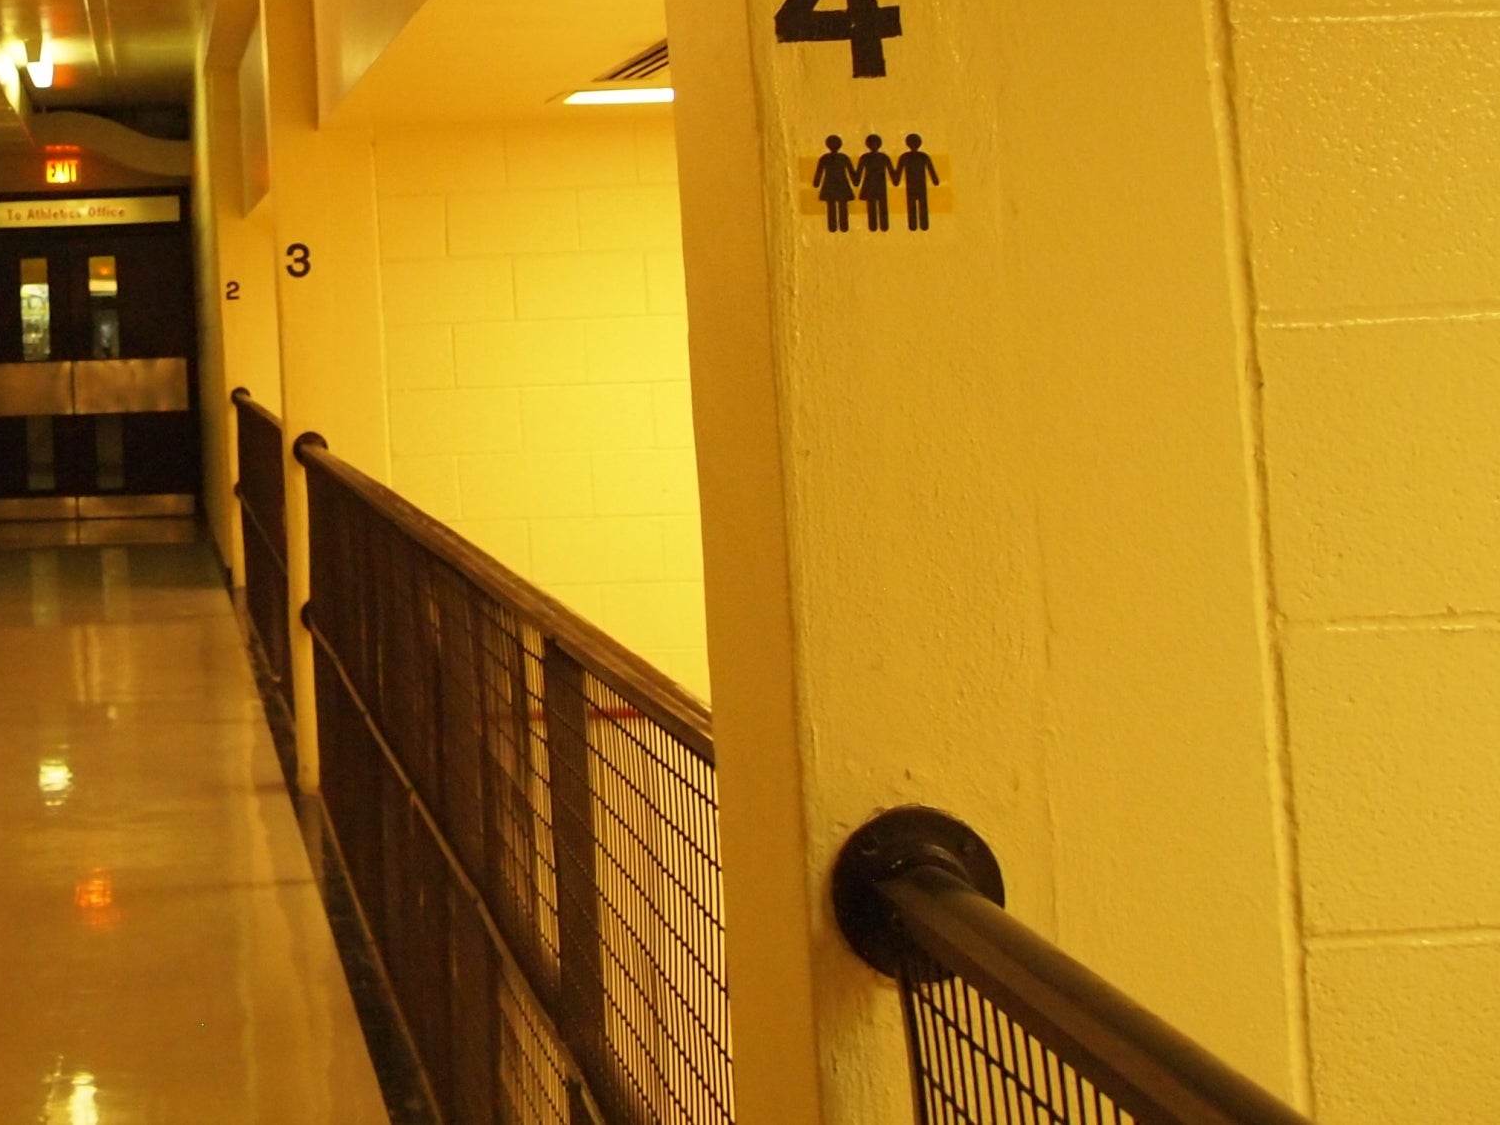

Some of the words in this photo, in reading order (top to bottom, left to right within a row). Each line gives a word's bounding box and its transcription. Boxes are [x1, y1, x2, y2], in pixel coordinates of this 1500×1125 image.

[46, 160, 78, 183] EXIT
[7, 209, 21, 221] To
[87, 206, 125, 218] Office
[286, 243, 311, 278] 3
[226, 281, 240, 300] 2
